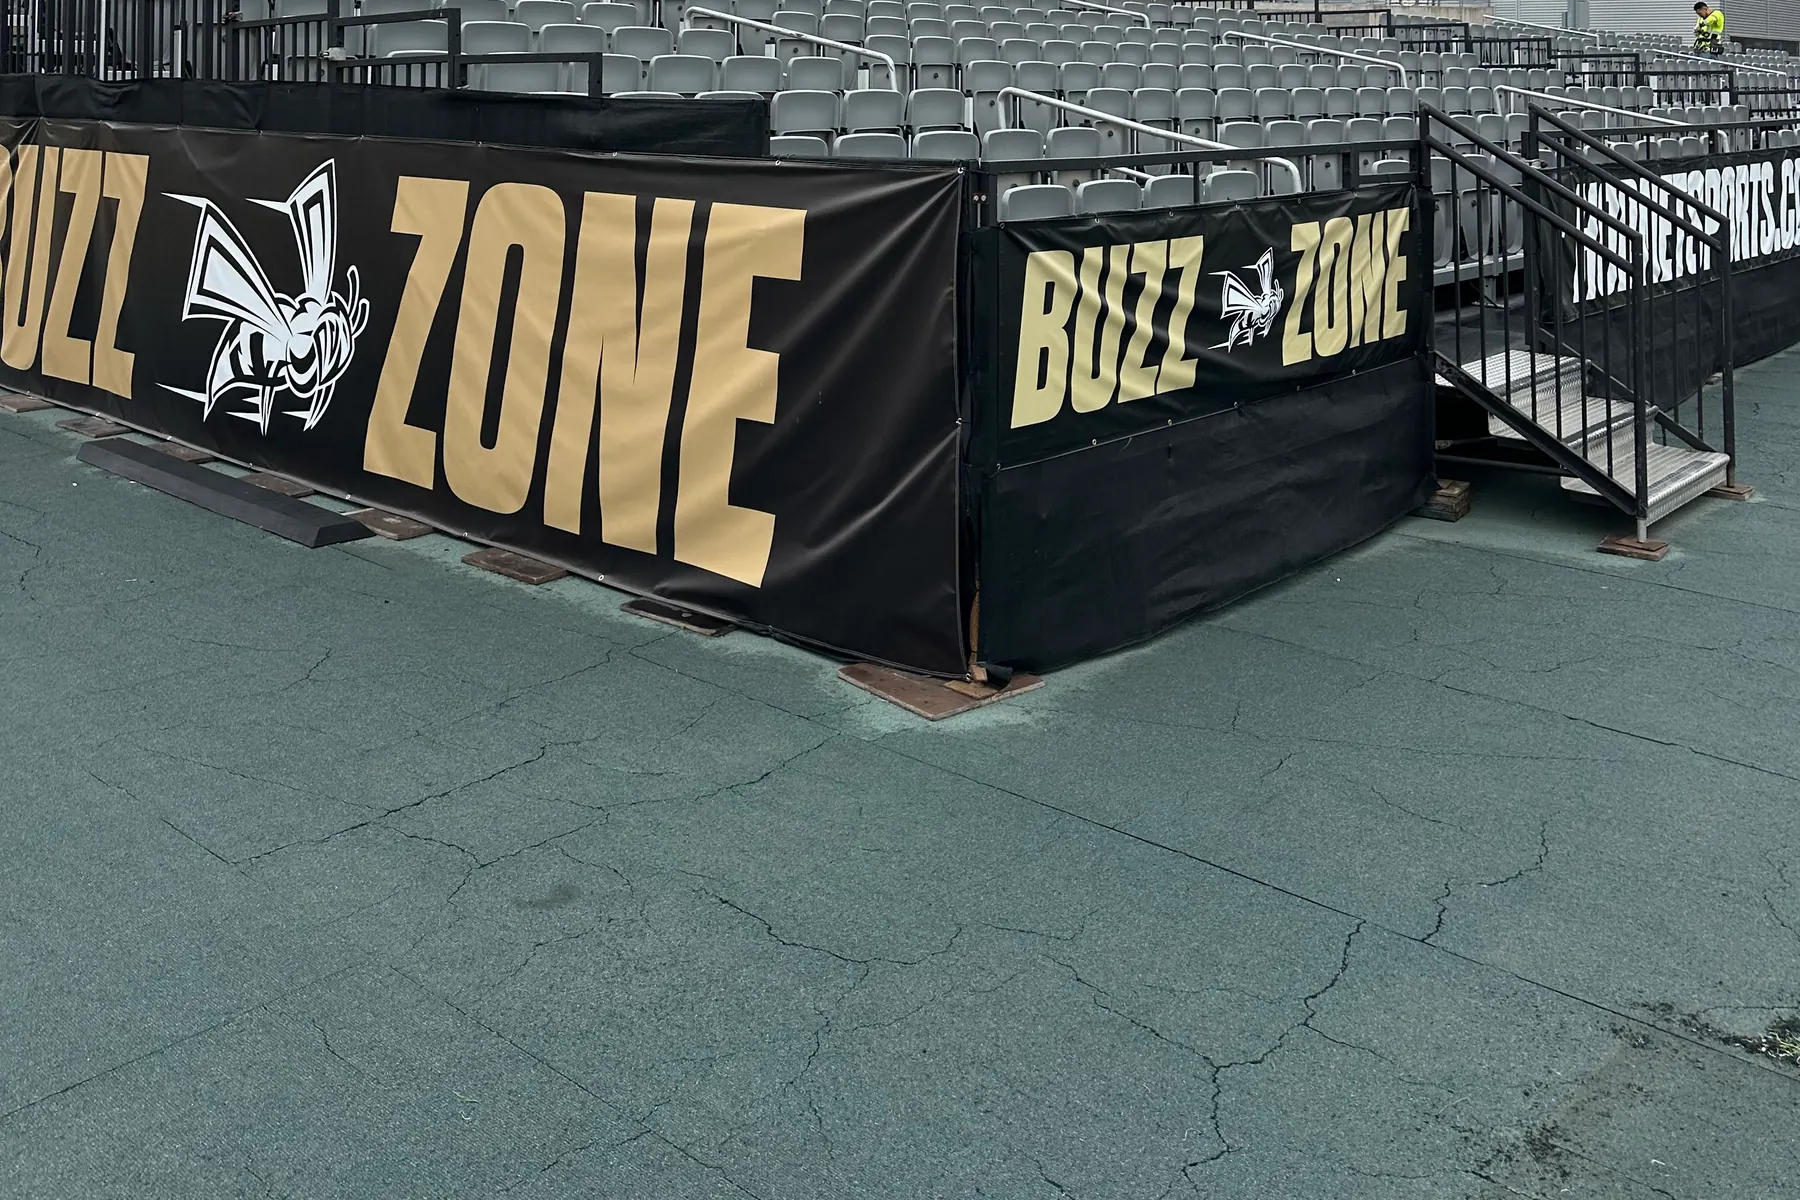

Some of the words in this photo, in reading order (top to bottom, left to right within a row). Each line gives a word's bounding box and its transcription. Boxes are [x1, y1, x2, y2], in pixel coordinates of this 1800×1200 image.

[363, 175, 807, 588] ZONE
[1010, 235, 1204, 429] BUZZ
[1281, 207, 1410, 366] ZONE
